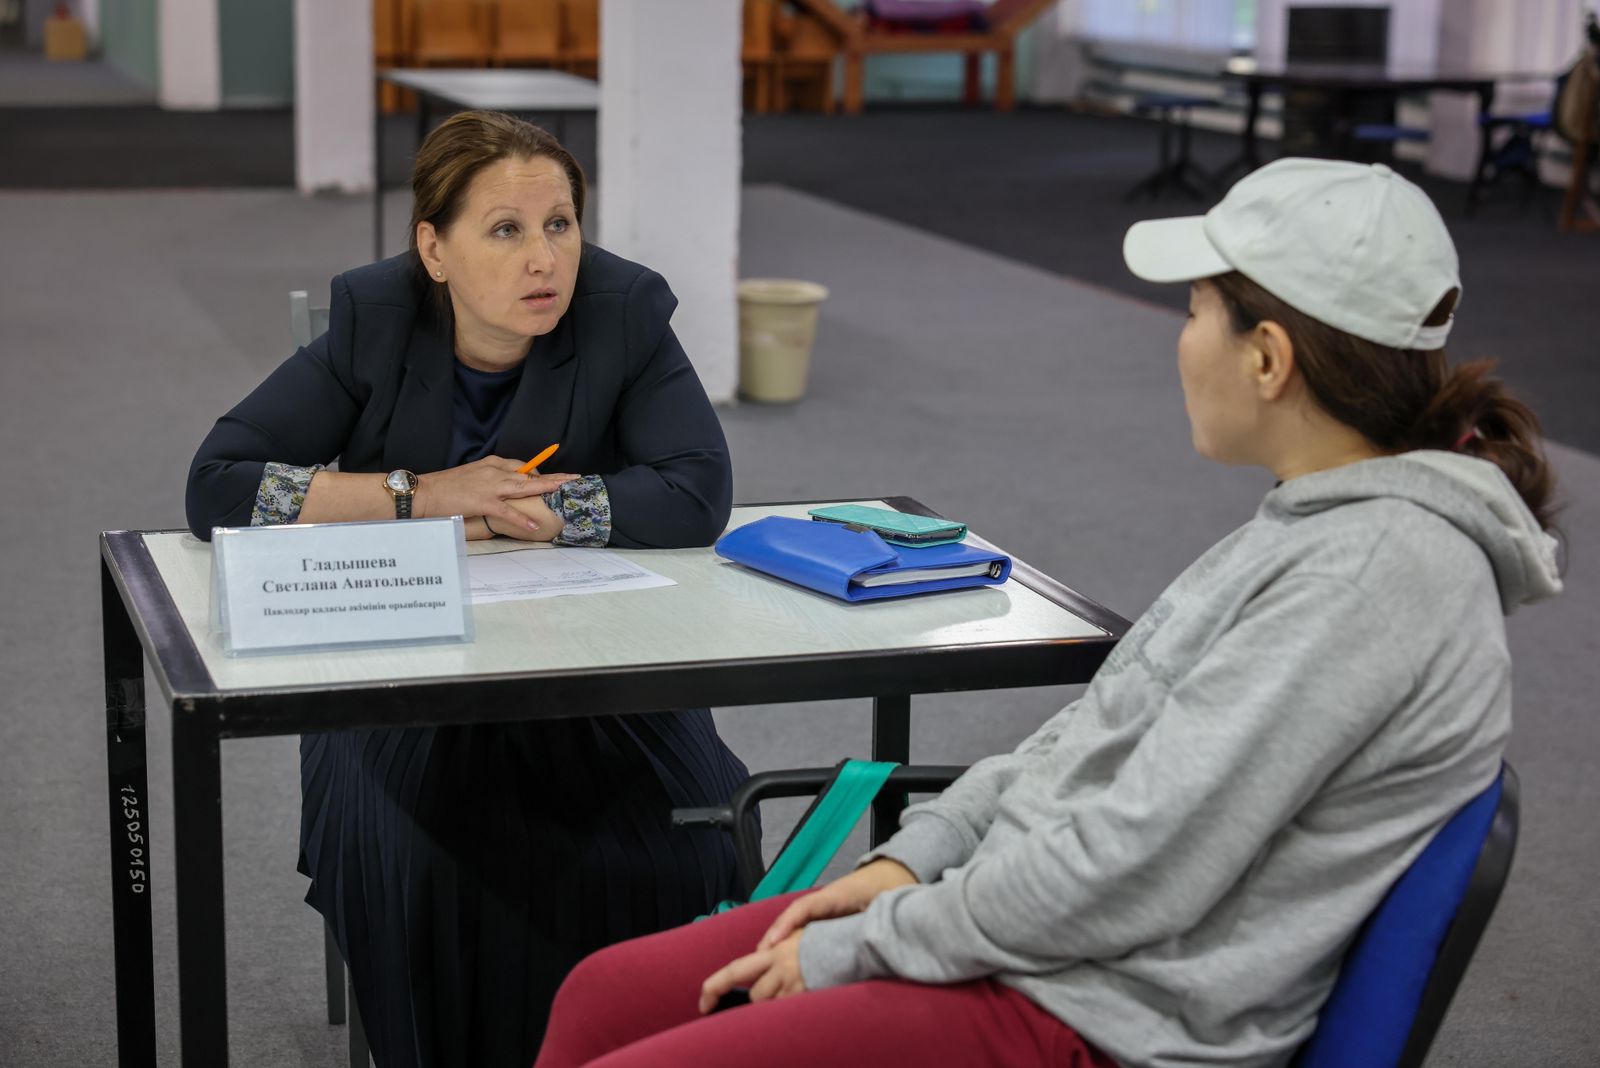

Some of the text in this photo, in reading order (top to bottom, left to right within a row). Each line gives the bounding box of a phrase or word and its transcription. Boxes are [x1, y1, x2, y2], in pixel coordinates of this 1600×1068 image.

[302, 558, 397, 572] Гладышева
[262, 575, 443, 594] Светлана Анатольевна
